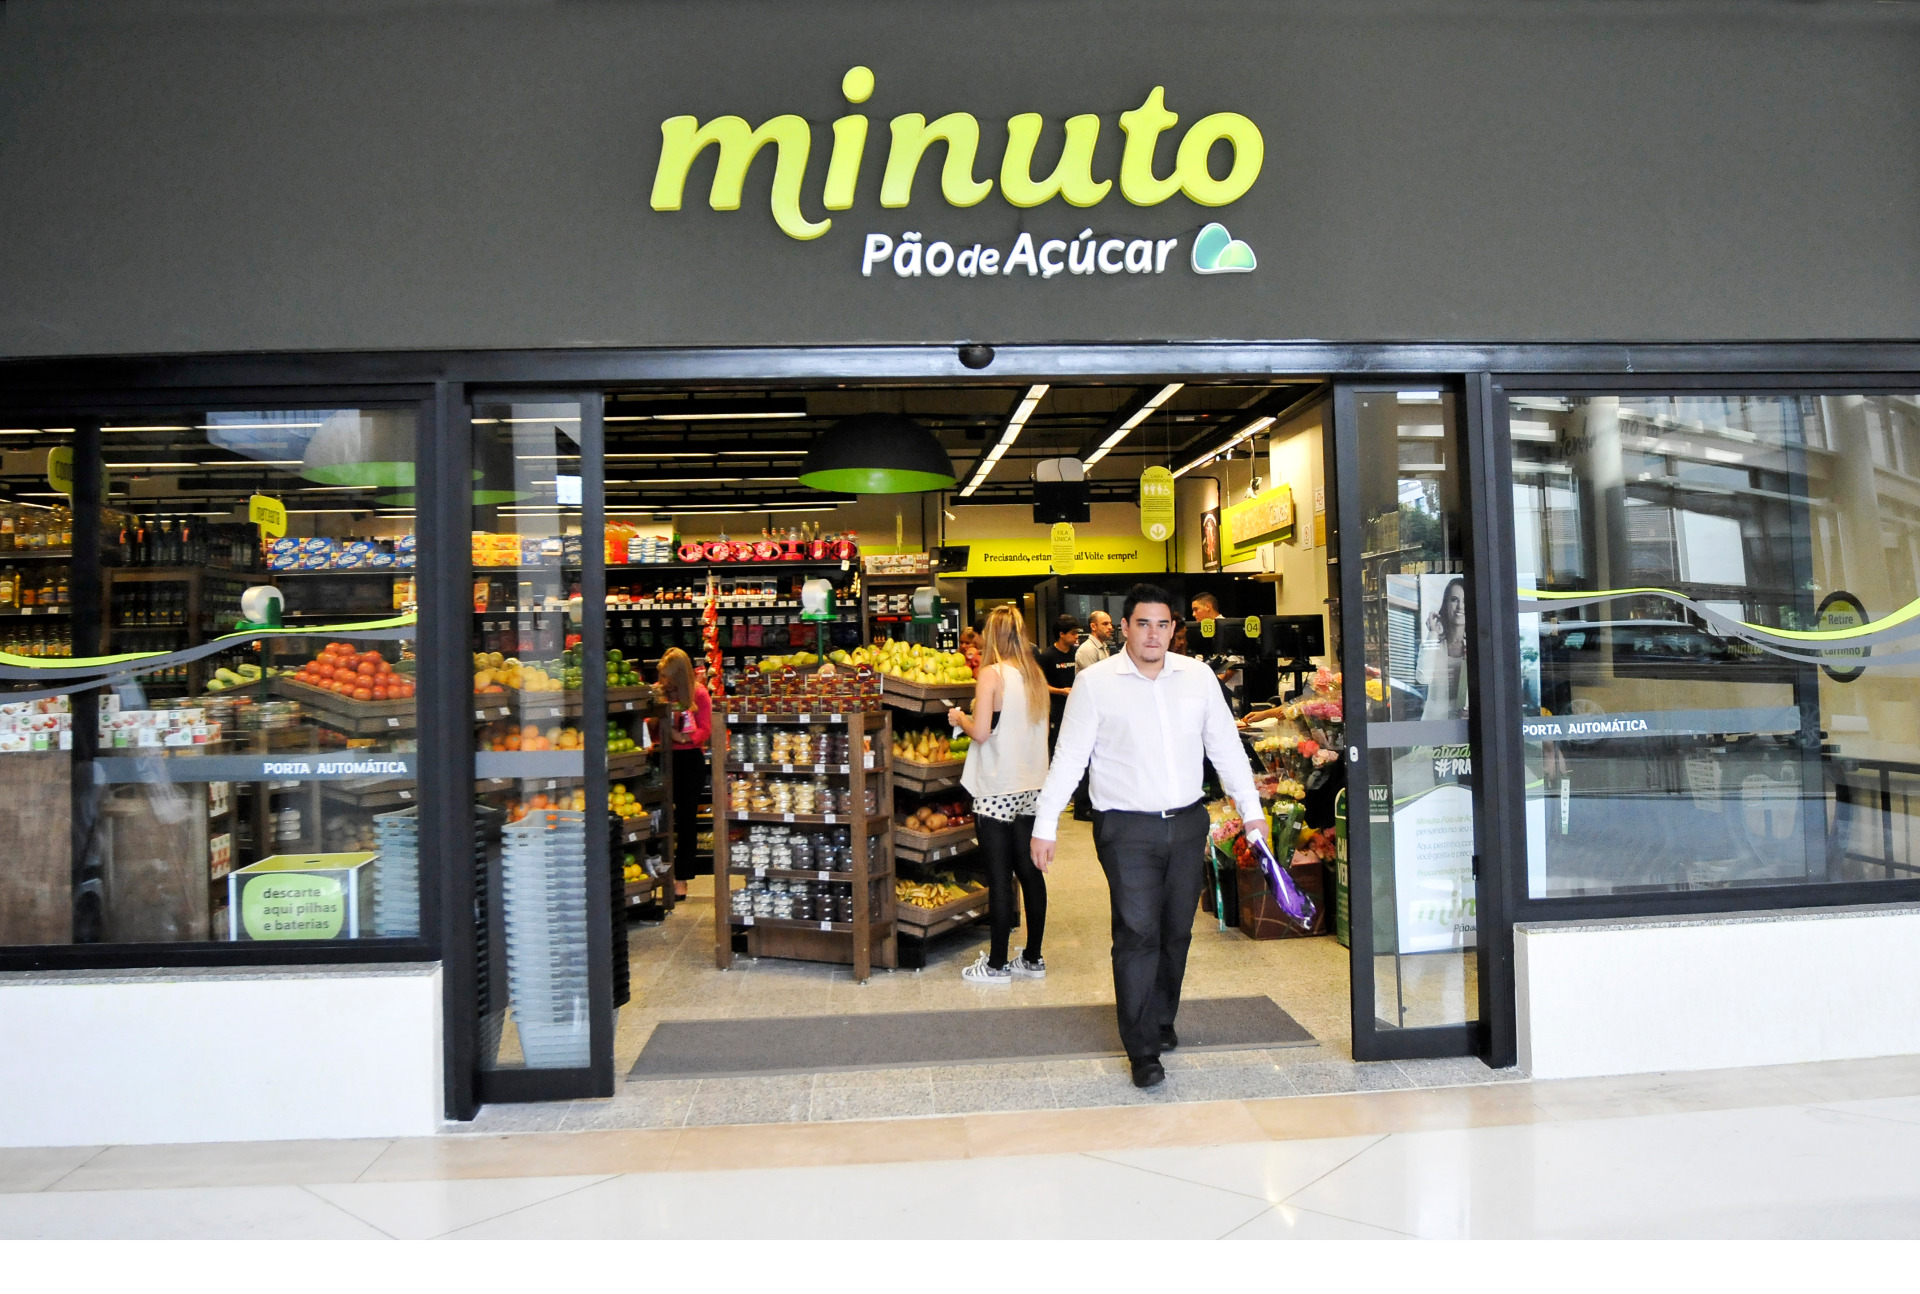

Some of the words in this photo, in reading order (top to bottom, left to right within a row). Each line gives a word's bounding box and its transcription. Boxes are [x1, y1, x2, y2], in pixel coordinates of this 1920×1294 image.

[650, 65, 1265, 241] minuto
[862, 231, 954, 277] Pão
[957, 244, 1000, 278] de
[1002, 228, 1178, 278] Açúcar
[984, 553, 1031, 563] Precisando,
[1085, 551, 1104, 561] Volte
[1107, 550, 1138, 562] sempre!
[1828, 613, 1854, 625] Retire
[1203, 625, 1213, 633] 03
[1246, 623, 1258, 632] 04
[1522, 723, 1563, 736] PORTA
[1568, 719, 1648, 735] AUTOMÁTICA
[263, 762, 311, 774] PORTA
[316, 759, 408, 774] AUTOMÁTICA
[263, 888, 321, 899] descarte
[263, 904, 293, 917] aqui
[296, 902, 337, 916] pilhas
[263, 922, 271, 931] e
[275, 919, 329, 931] baterias
